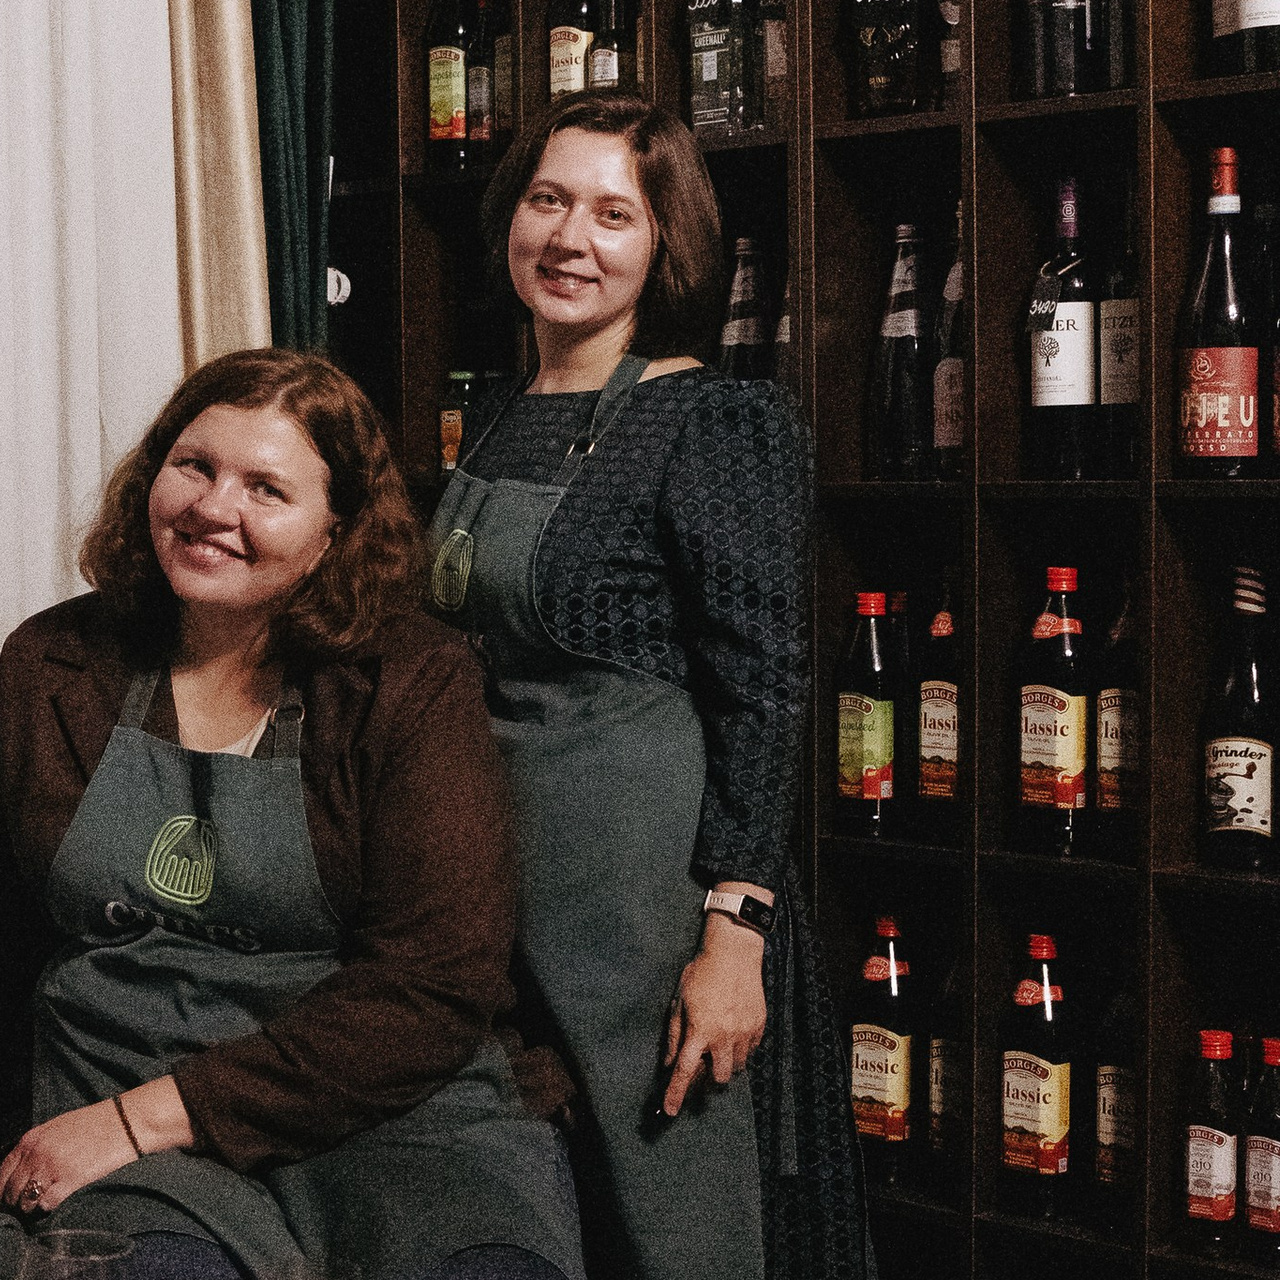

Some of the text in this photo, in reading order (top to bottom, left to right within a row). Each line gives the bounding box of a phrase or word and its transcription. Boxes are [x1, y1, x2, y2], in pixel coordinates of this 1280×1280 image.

[551, 32, 574, 41] ORGES
[551, 53, 581, 69] lassic
[1030, 300, 1056, 315] 3490
[1184, 444, 1226, 452] OSSO
[921, 690, 957, 703] BORGES
[1022, 693, 1060, 707] BORGES
[839, 698, 866, 711] ORGES
[1021, 716, 1070, 737] lassic
[1211, 745, 1267, 762] Grinder
[852, 1032, 890, 1047] BORGES
[853, 1052, 899, 1074] lassic
[1004, 1060, 1042, 1075] BORGES
[1189, 1130, 1219, 1143] ORGES
[1191, 1160, 1212, 1172] ajo
[1252, 1170, 1272, 1183] ajo
